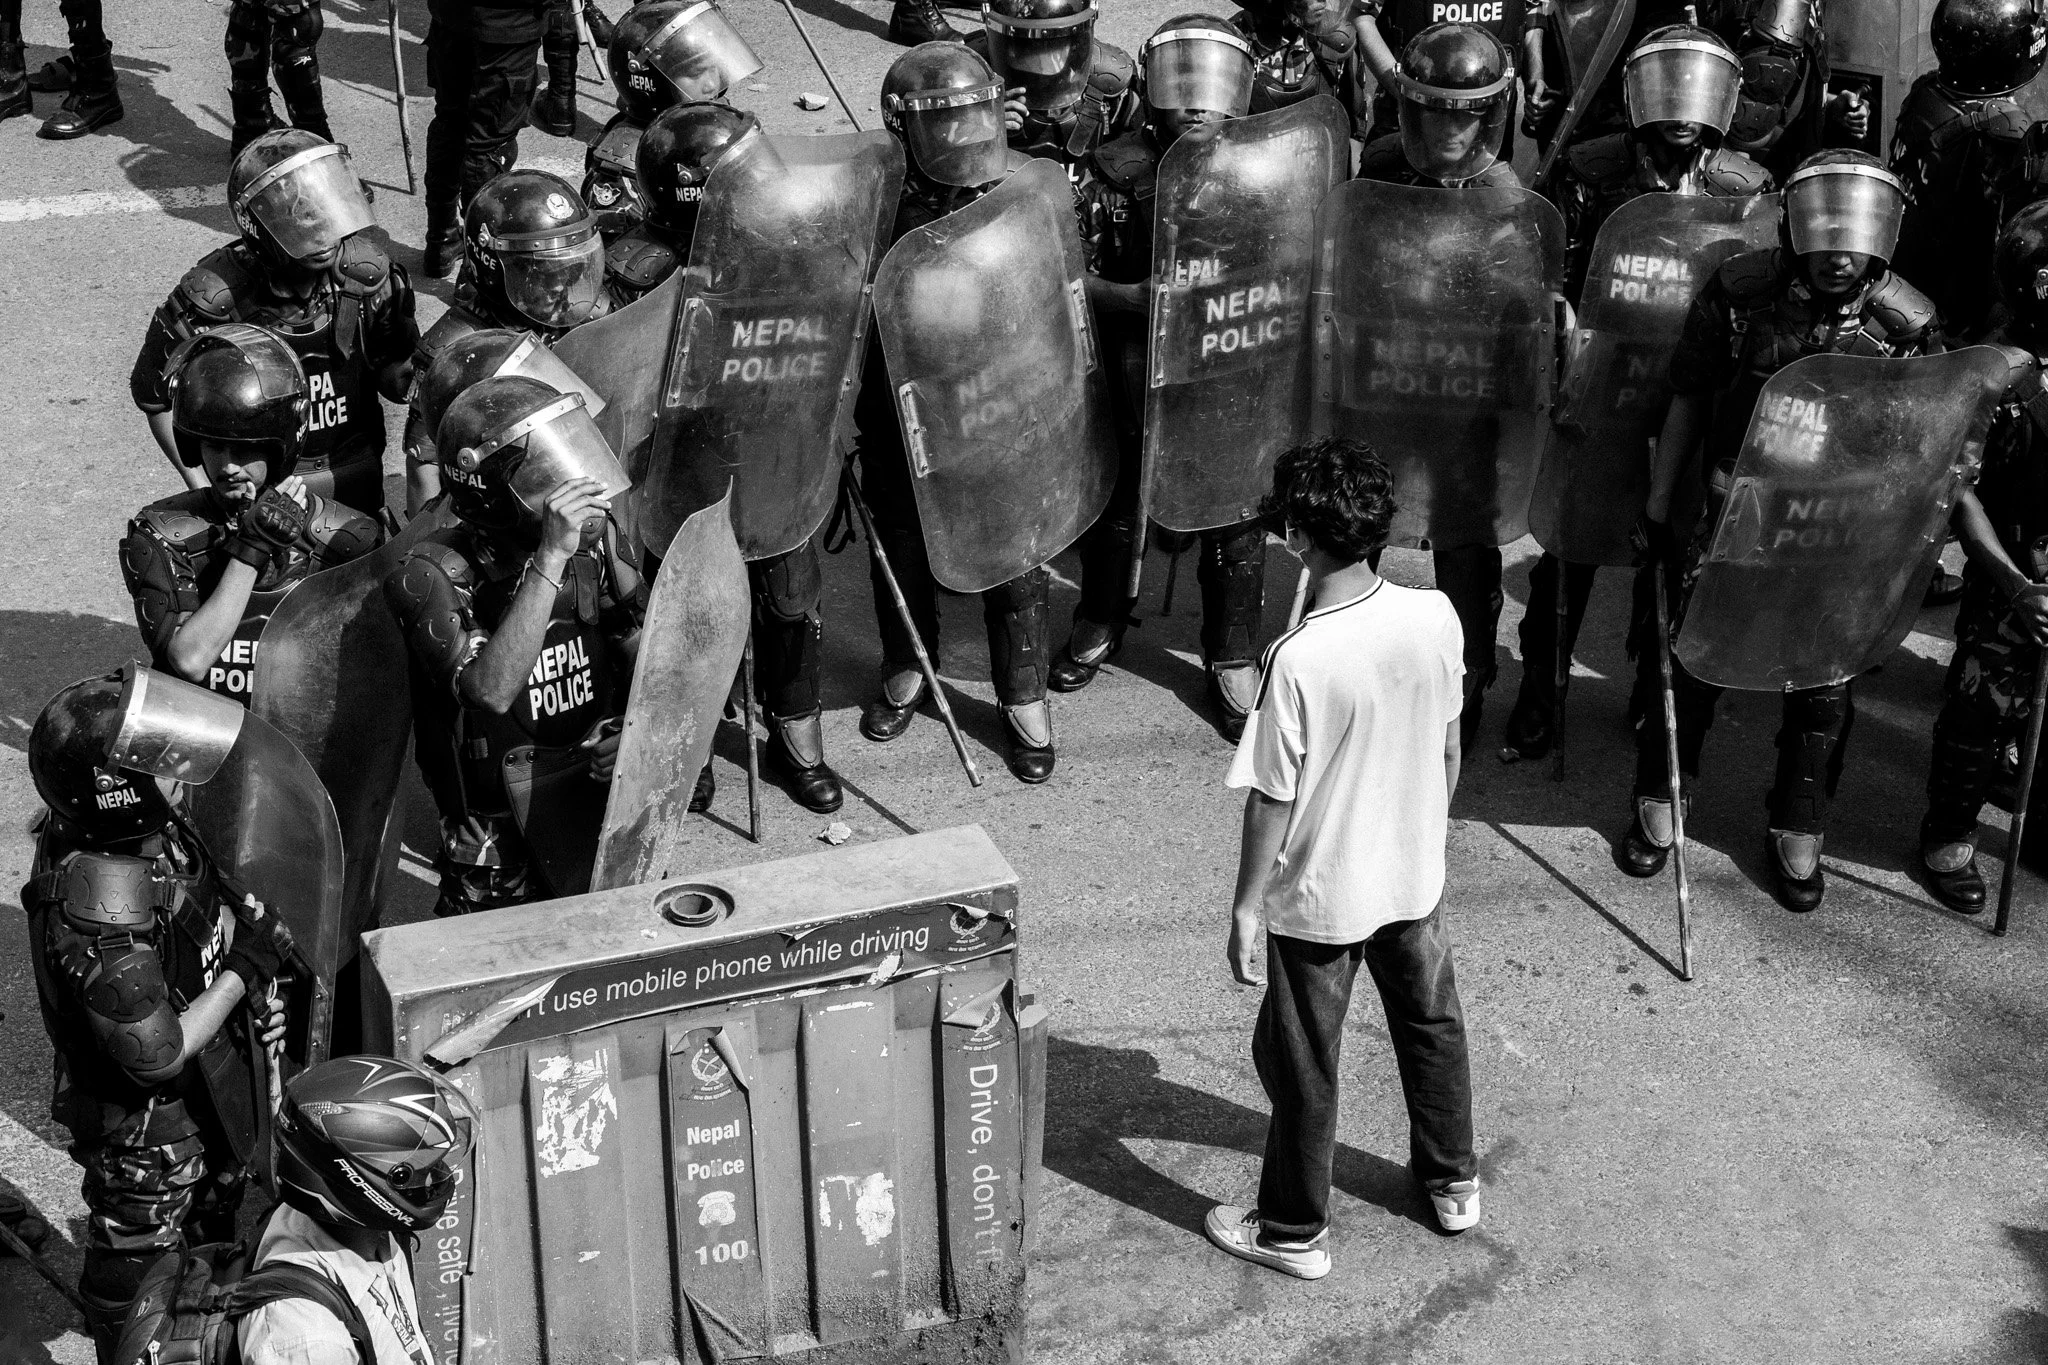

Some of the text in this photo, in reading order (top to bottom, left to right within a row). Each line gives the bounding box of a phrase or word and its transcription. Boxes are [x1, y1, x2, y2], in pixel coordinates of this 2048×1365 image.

[1432, 2, 1503, 23] POLICE
[884, 110, 903, 131] EPAL
[1612, 253, 1694, 283] NEPAL
[1205, 281, 1299, 324] NEPAL
[731, 315, 828, 348] NEPAL
[722, 352, 827, 384] POLICE
[1368, 370, 1496, 398] POLICE
[1761, 391, 1828, 432] NEPAL
[444, 463, 487, 489] NEPAL
[528, 635, 590, 686] NEPAL
[529, 668, 595, 721] POLICE
[95, 787, 142, 810] NEPAL
[553, 988, 598, 1013] use
[605, 967, 688, 1002] mobile
[695, 954, 772, 990] phone
[780, 939, 843, 969] while
[849, 926, 930, 958] driving
[967, 1064, 999, 1155] Drive,
[686, 1119, 741, 1146] Nepal
[687, 1158, 746, 1181] Police
[333, 1158, 416, 1227] PROFESSIONAL
[972, 1164, 1002, 1240] don't
[694, 1240, 749, 1266] 100
[392, 1317, 414, 1347] PRESS
